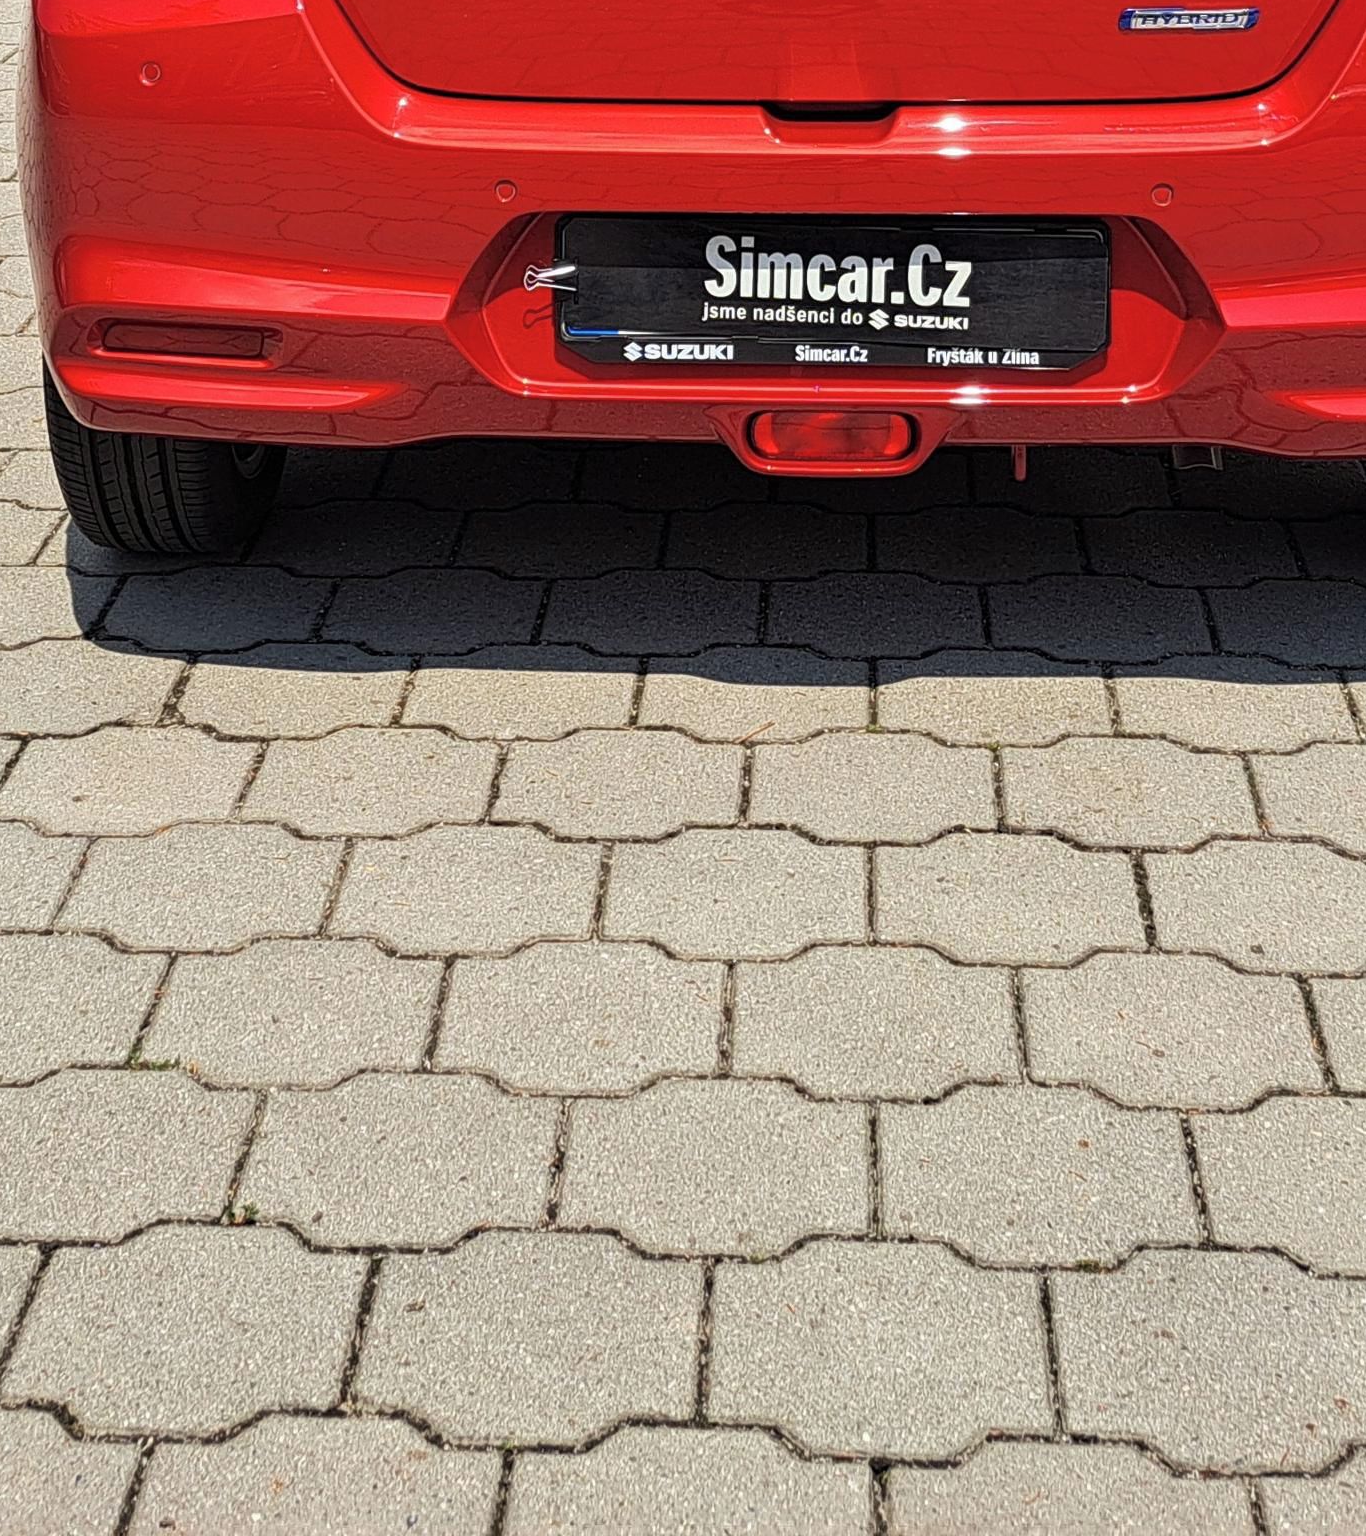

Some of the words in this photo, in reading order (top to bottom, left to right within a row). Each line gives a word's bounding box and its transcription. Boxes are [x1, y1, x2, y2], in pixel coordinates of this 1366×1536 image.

[704, 235, 972, 307] Simcar.Cz
[701, 302, 747, 321] jsme
[753, 305, 835, 324] nadšenci
[841, 308, 863, 325] do
[894, 314, 969, 330] SUZUKI
[643, 344, 734, 360] SUZUKI
[794, 345, 868, 362] Simcar.Cz
[927, 347, 984, 367] Fryšták
[988, 354, 998, 364] u
[1001, 348, 1040, 365] Zlína
